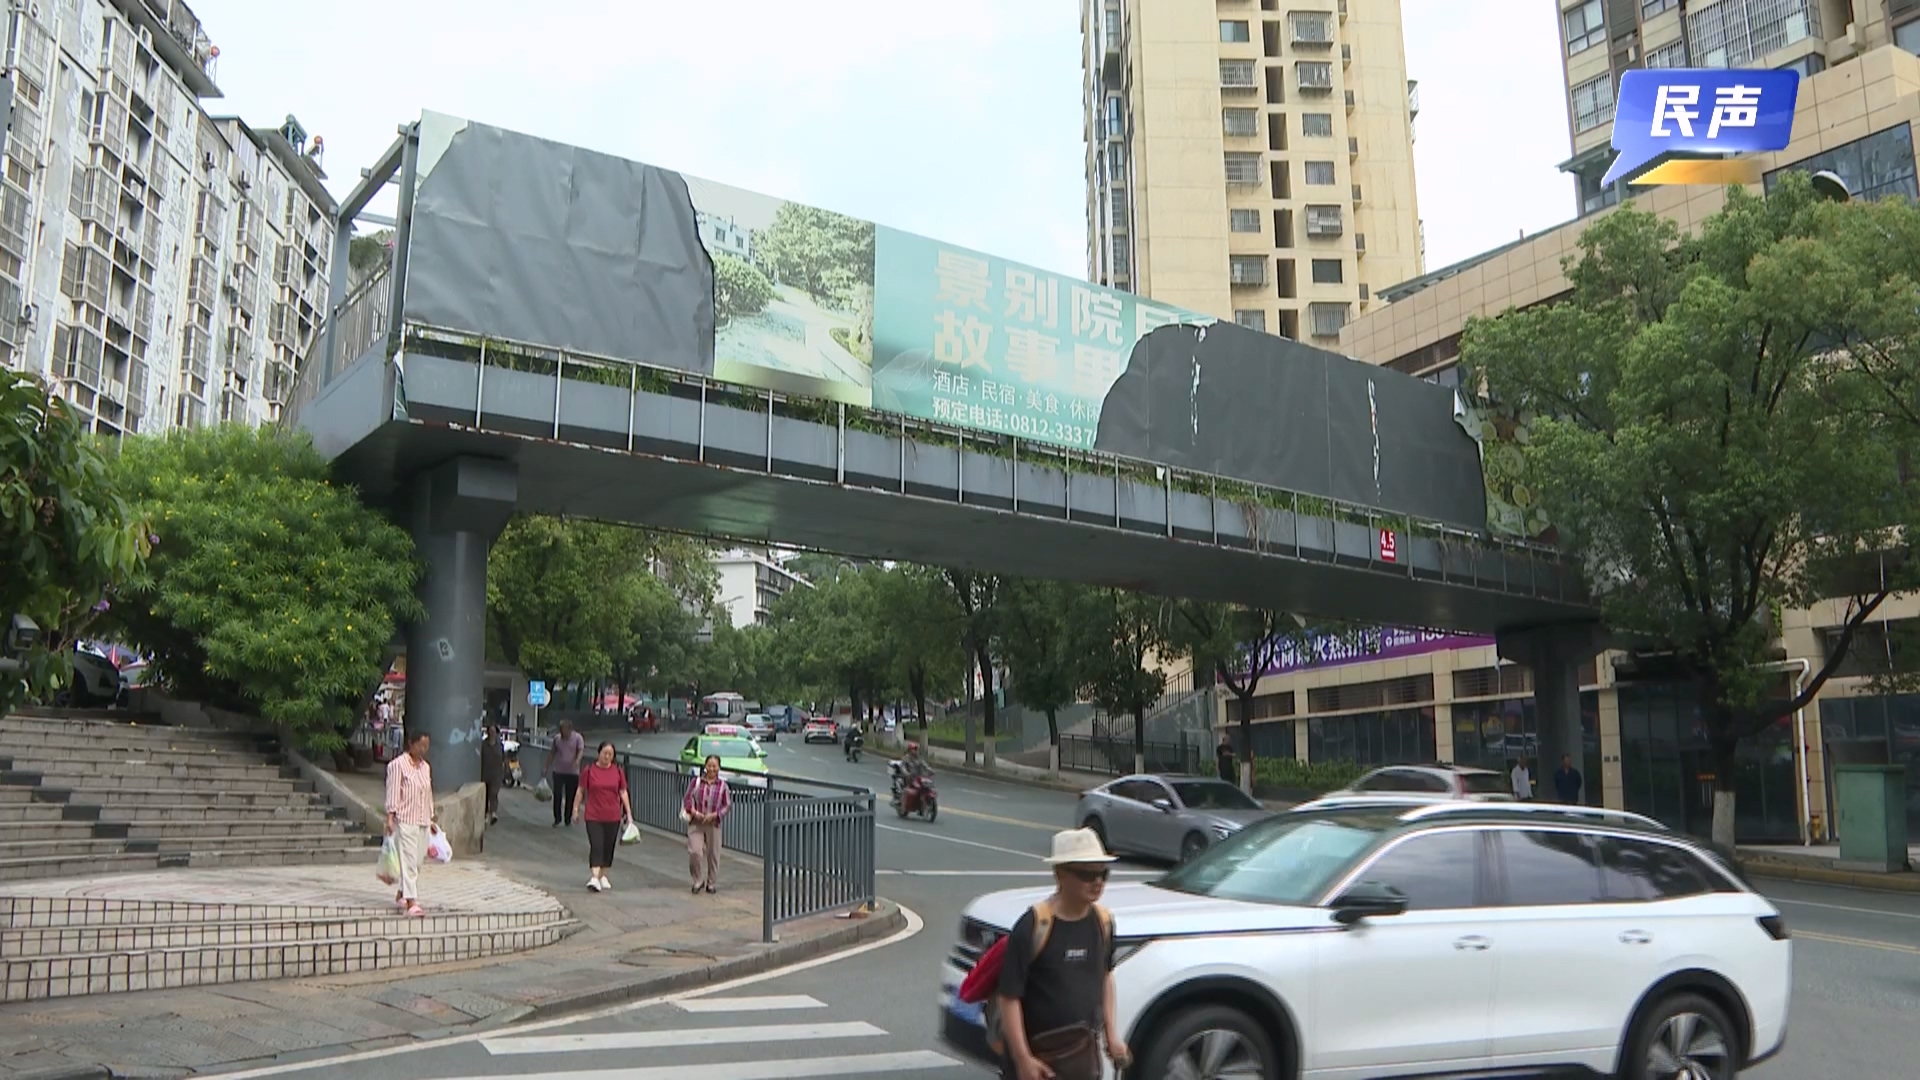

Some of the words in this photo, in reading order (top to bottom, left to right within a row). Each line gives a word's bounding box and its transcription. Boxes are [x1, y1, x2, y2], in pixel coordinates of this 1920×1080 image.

[933, 248, 1217, 345] 景别院
[931, 396, 1097, 446] 预定电话:0812-3337
[1381, 530, 1395, 550] 4.5
